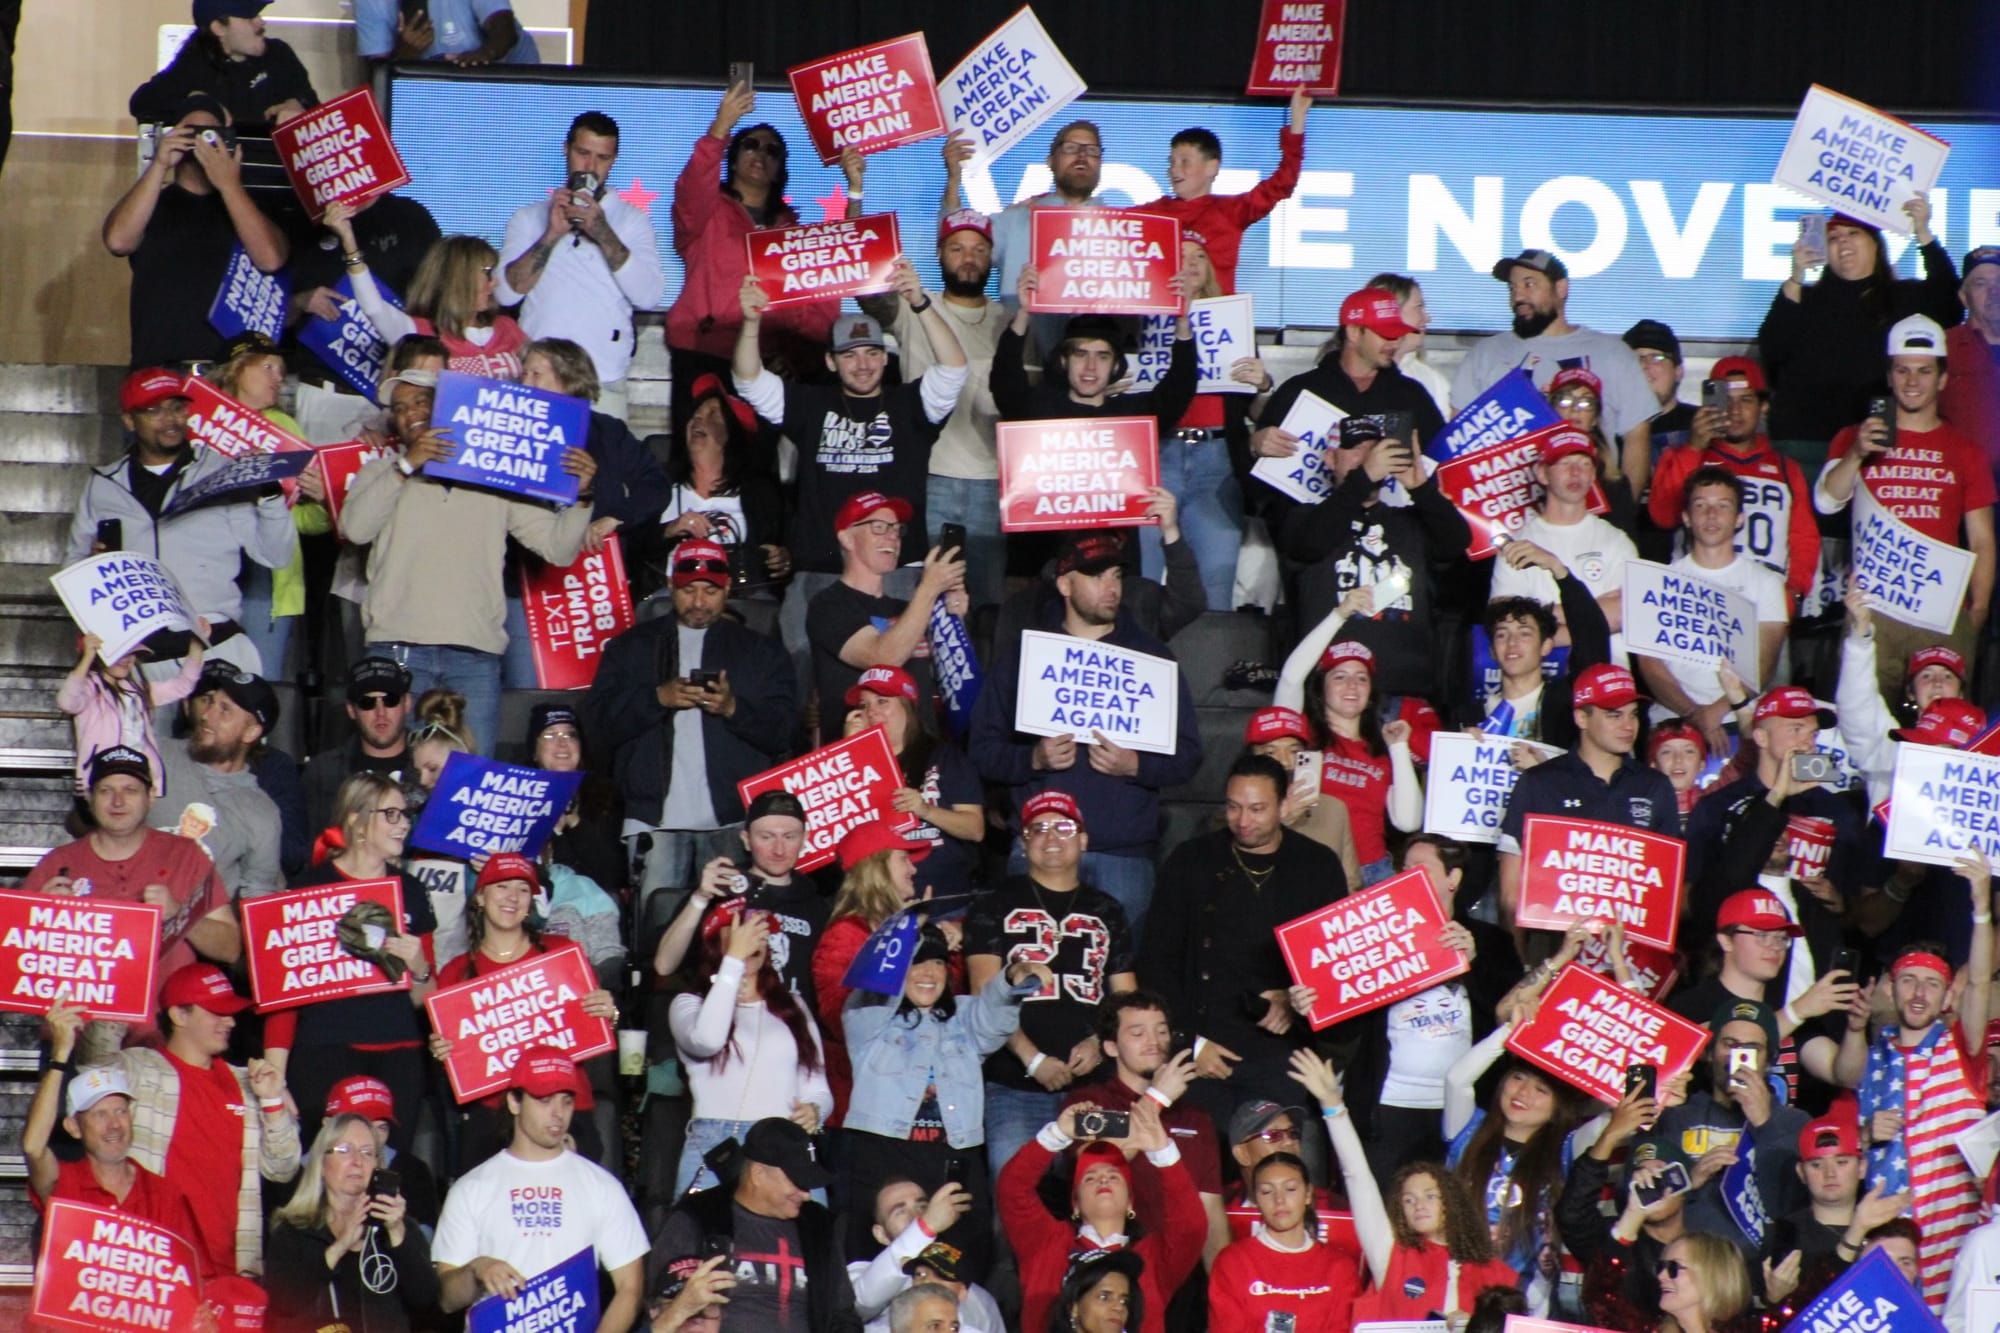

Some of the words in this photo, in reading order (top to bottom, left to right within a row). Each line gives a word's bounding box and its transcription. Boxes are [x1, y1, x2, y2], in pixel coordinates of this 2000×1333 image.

[1281, 2, 1324, 21] MAKE
[1266, 23, 1333, 42] AMERICA
[956, 42, 1010, 93] MAKE
[1273, 44, 1325, 62] GREAT
[820, 53, 888, 88] MAKE
[953, 48, 1037, 122] AMERICA
[1270, 64, 1323, 82] AGAIN!
[811, 70, 914, 112] AMERICA
[970, 70, 1034, 127] GREAT
[295, 109, 348, 146] MAKE
[825, 92, 902, 130] GREAT
[982, 85, 1050, 146] AGAIN!
[292, 123, 371, 171] AMERICA
[832, 111, 912, 150] AGAIN!
[1839, 114, 1908, 155] MAKE
[305, 147, 364, 188] GREAT
[1811, 126, 1914, 181] AMERICA
[313, 164, 377, 207] AGAIN!
[1818, 151, 1897, 193] GREAT
[1807, 169, 1891, 214] AGAIN!
[764, 228, 880, 257] AMERICA
[784, 220, 856, 240] MAKE
[1071, 218, 1144, 238] MAKE
[781, 244, 864, 272] GREAT
[1049, 238, 1164, 259] AMERICA
[225, 254, 250, 312] GAIN!
[783, 262, 870, 293] AGAIN!
[1064, 260, 1150, 279] GREAT
[237, 266, 263, 324] REAT
[1062, 280, 1151, 300] AGAIN!
[1138, 349, 1220, 365] GRT
[1136, 367, 1221, 382] AGN!
[477, 388, 551, 420] MAKE
[187, 413, 250, 457] AMER
[212, 404, 281, 453] MAKE
[452, 405, 565, 445] AMERICA
[1040, 429, 1116, 450] MAKE
[1446, 400, 1505, 453] MAKE
[1453, 407, 1536, 459] ERICA
[464, 428, 550, 460] GREAT
[1885, 448, 1943, 463] MAKE
[457, 448, 547, 484] AGAIN!
[1019, 450, 1138, 472] AMERICA
[1469, 443, 1538, 481] MAKE
[1866, 466, 1956, 484] AMERICA
[1035, 472, 1124, 493] GREAT
[1462, 464, 1541, 506] AMERI
[1742, 484, 1784, 511] SA
[1877, 486, 1943, 501] GREAT
[1034, 493, 1126, 515] AGAIN!
[1482, 484, 1545, 518] GREA
[1883, 505, 1941, 519] GAIN
[1868, 513, 1929, 561] MAKE
[96, 560, 164, 578] MAKE
[583, 554, 615, 630] 88022
[1663, 575, 1726, 608] MAKE
[1856, 574, 1923, 613] GAIN!
[541, 590, 571, 652] TEXT
[563, 574, 596, 660] TRUMP
[1642, 590, 1744, 635] AMERICA
[1658, 611, 1732, 644] GREAT
[1065, 648, 1135, 676] MAKE
[1655, 630, 1735, 664] AGAIN!
[1041, 665, 1155, 699] AMERICA
[1055, 687, 1140, 713] GREAT
[1050, 707, 1140, 734] AGAIN!
[782, 751, 855, 794] MAKE
[1475, 746, 1513, 768] MA
[480, 771, 550, 798] MAKE
[798, 765, 882, 811] ERICA
[1451, 766, 1523, 788] AMER
[1943, 762, 2000, 790] MAK
[451, 786, 552, 817] AMERICA
[804, 789, 871, 831] REAT
[1466, 787, 1513, 808] GRE
[1919, 781, 2000, 812] AMERI
[459, 809, 537, 836] GREAT
[1932, 805, 2000, 834] GREA
[445, 826, 528, 852] AGAIN!
[1568, 830, 1646, 861] MAKE
[416, 867, 459, 893] USA
[1542, 850, 1663, 888] AMERICA
[1558, 873, 1648, 903] GREAT
[29, 906, 113, 934] MAKE
[282, 893, 356, 923] MAKE
[1321, 894, 1396, 939] MAKE
[1, 927, 134, 960] AMERICA
[265, 917, 341, 950] AMER
[1311, 907, 1427, 969] AMERICA
[18, 953, 116, 980] GREAT
[281, 942, 352, 968] GREA
[1004, 908, 1111, 1006] 23
[1331, 932, 1417, 982] GREAT
[12, 976, 116, 1004] AGAIN!
[282, 959, 373, 992] AGAIN!
[470, 968, 549, 1011] MAKE
[1340, 952, 1431, 1004] AGAIN!
[459, 984, 578, 1040] AMERICA
[1591, 988, 1666, 1037] MAKE
[479, 1008, 566, 1054] GREAT
[1556, 997, 1668, 1065] AMERICA
[485, 1028, 577, 1077] AGN!
[1542, 1039, 1628, 1093] AGAIN
[510, 1187, 563, 1201] FOUR
[512, 1202, 563, 1215] MORE
[513, 1216, 562, 1228] YEARS
[93, 1220, 172, 1258] MAKE
[63, 1240, 192, 1286] AMERICA
[78, 1267, 176, 1306] GREAT
[505, 1276, 568, 1322] MAKE
[1249, 1281, 1331, 1299] Champion
[69, 1291, 173, 1331] AGAIN!
